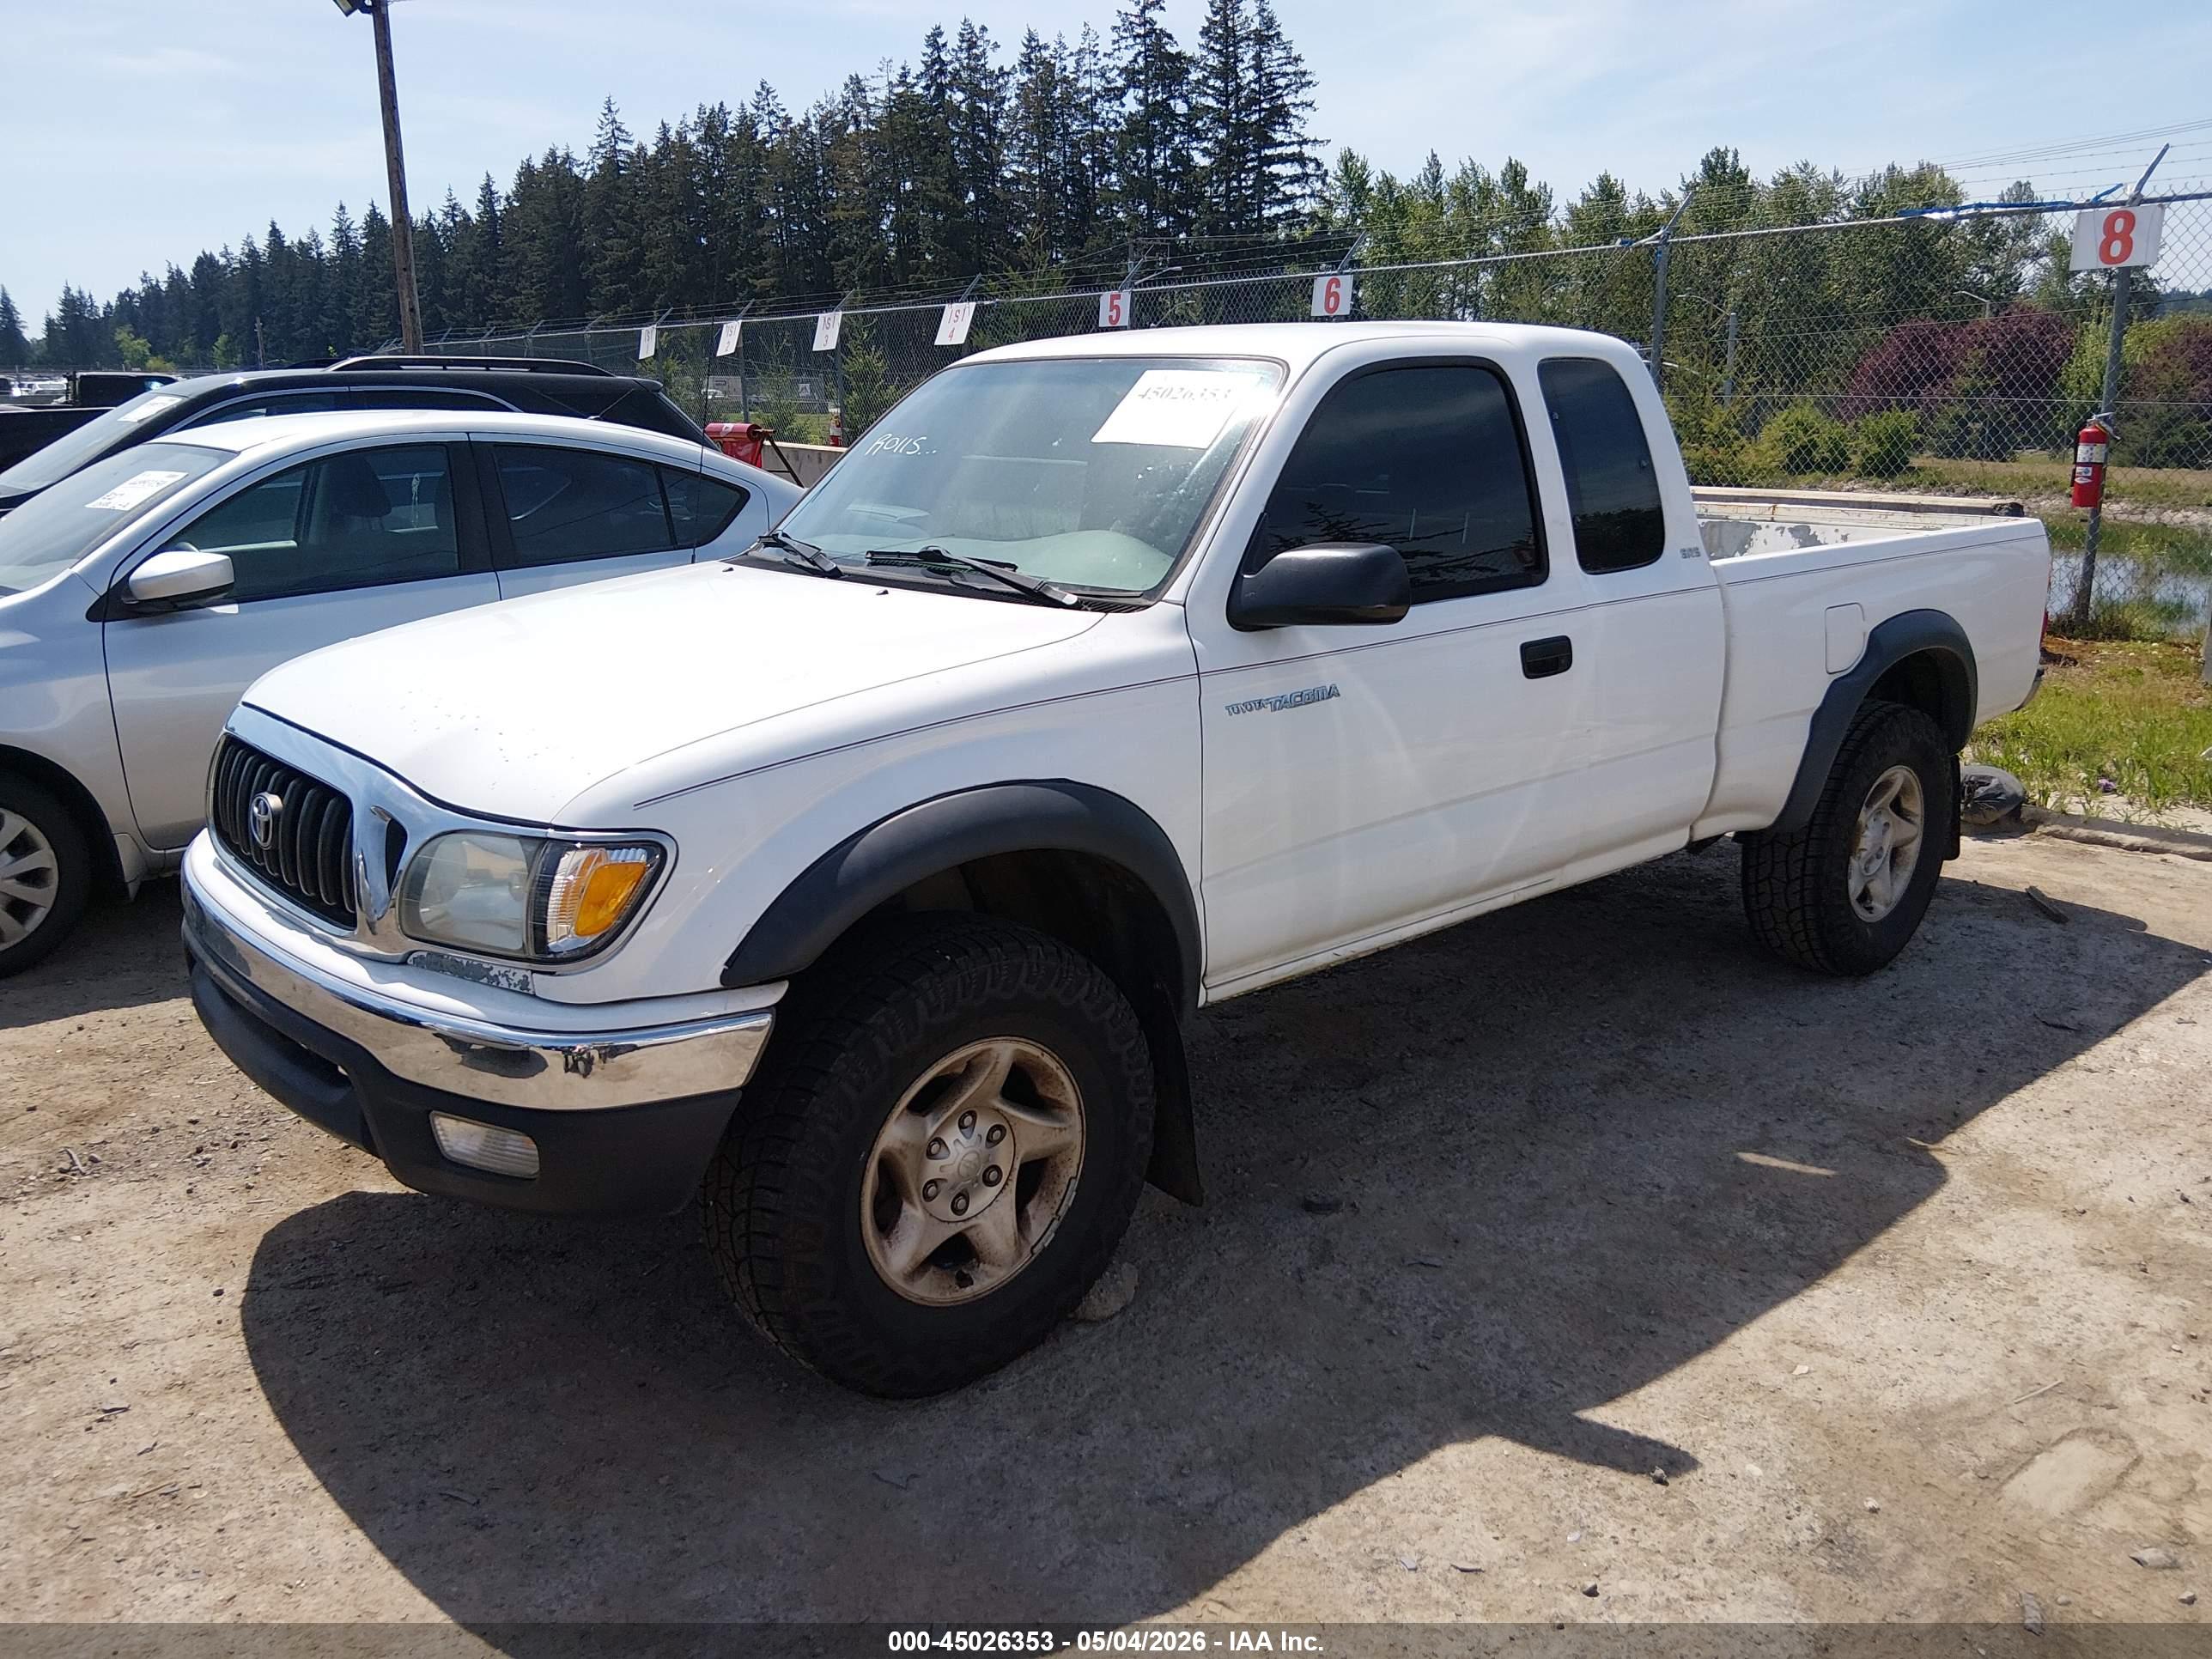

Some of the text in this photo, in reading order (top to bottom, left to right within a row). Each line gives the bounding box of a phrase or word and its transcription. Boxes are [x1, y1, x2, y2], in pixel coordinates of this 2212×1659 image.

[2099, 210, 2136, 265] 8
[1108, 293, 1121, 326] 5
[1323, 276, 1341, 314] 6
[947, 326, 956, 342] 4
[1225, 684, 1341, 717] TOYOTA TACOMA
